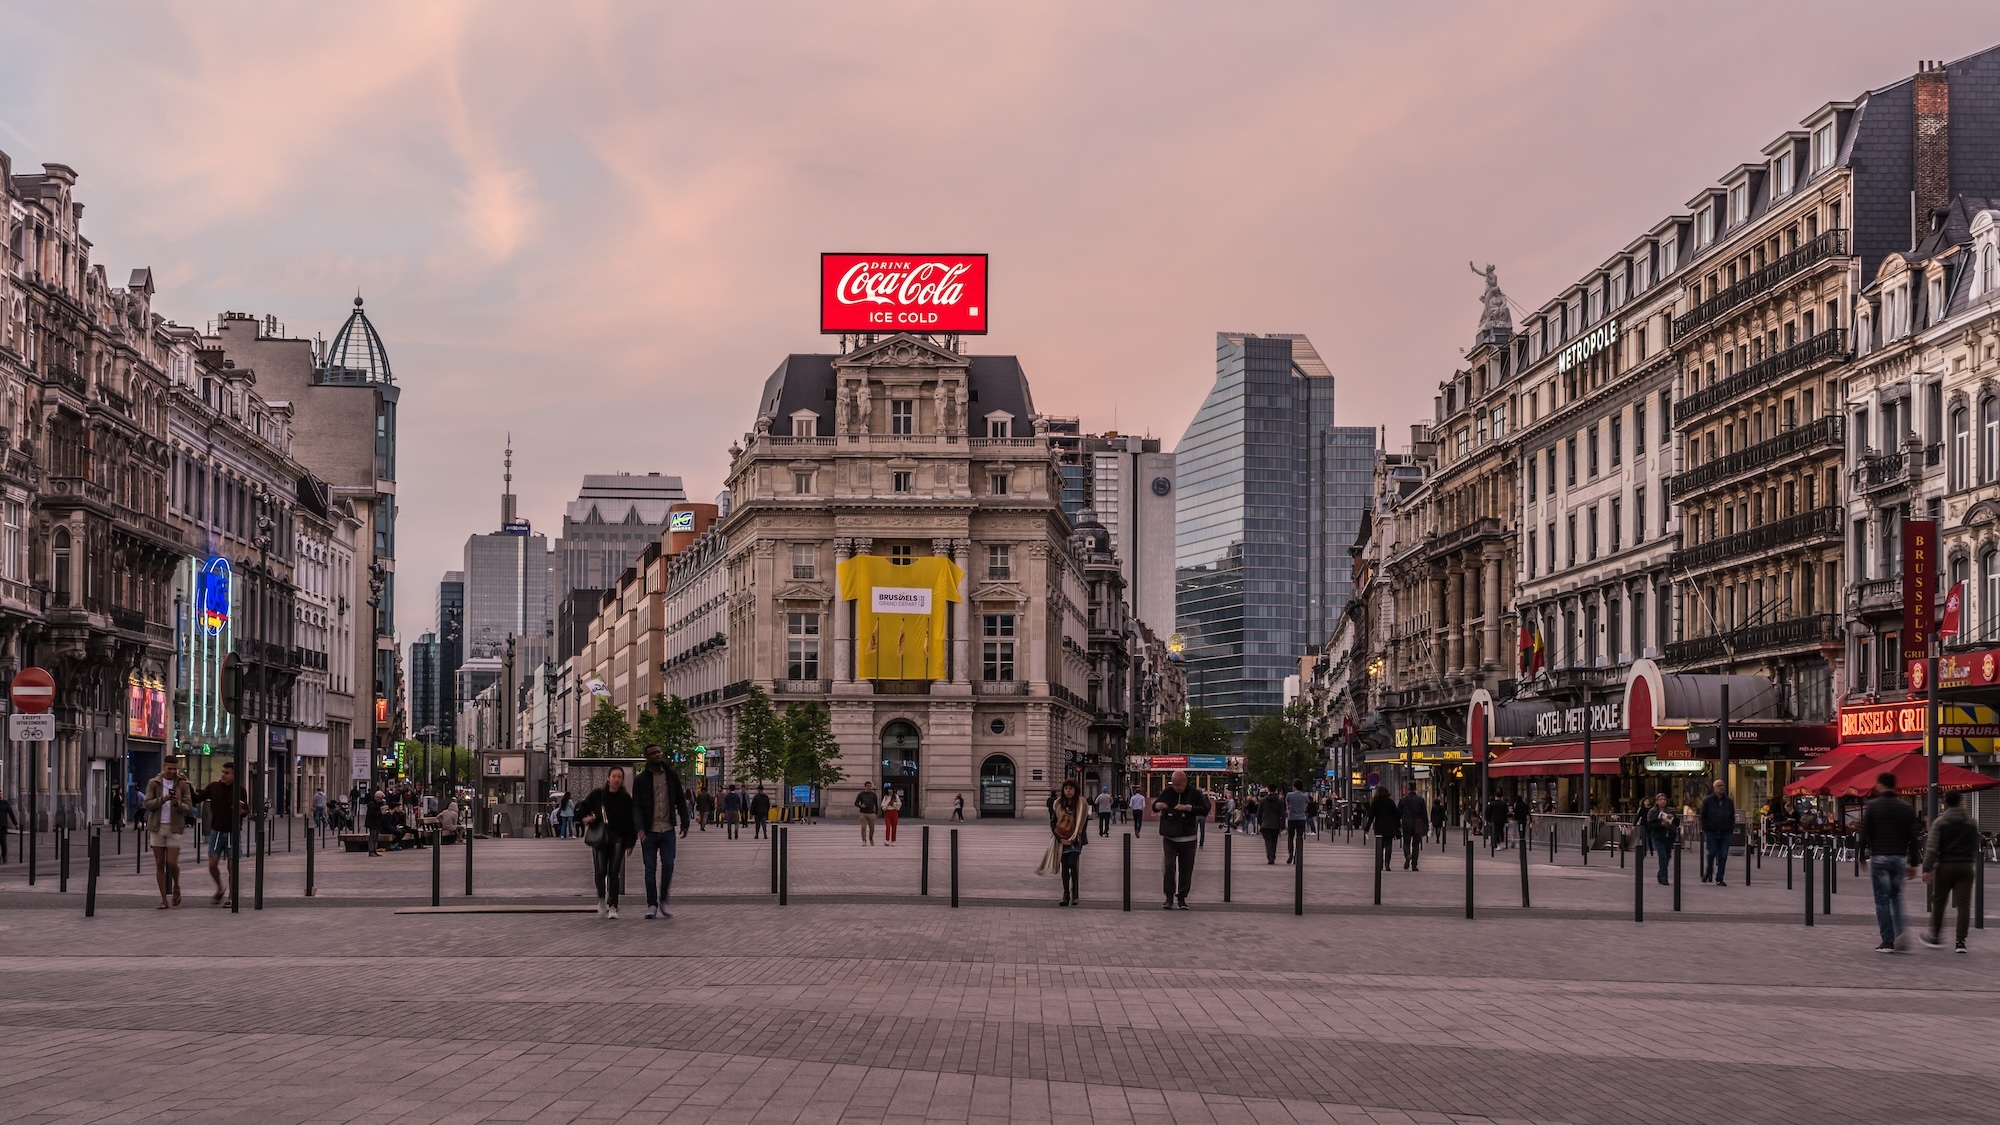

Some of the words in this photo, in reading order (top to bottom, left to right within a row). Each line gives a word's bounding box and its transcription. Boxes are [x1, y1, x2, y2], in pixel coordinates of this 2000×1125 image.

[837, 262, 972, 305] Coca-Cola
[870, 312, 893, 323] ICE
[898, 312, 938, 323] COLD
[1559, 320, 1616, 374] METROPOLE
[671, 511, 693, 527] AG
[1914, 536, 1925, 643] BRUSSELS
[1537, 711, 1561, 735] HOTEL
[1842, 710, 1893, 736] BRUSSELS
[1901, 787, 1930, 795] HECTO
